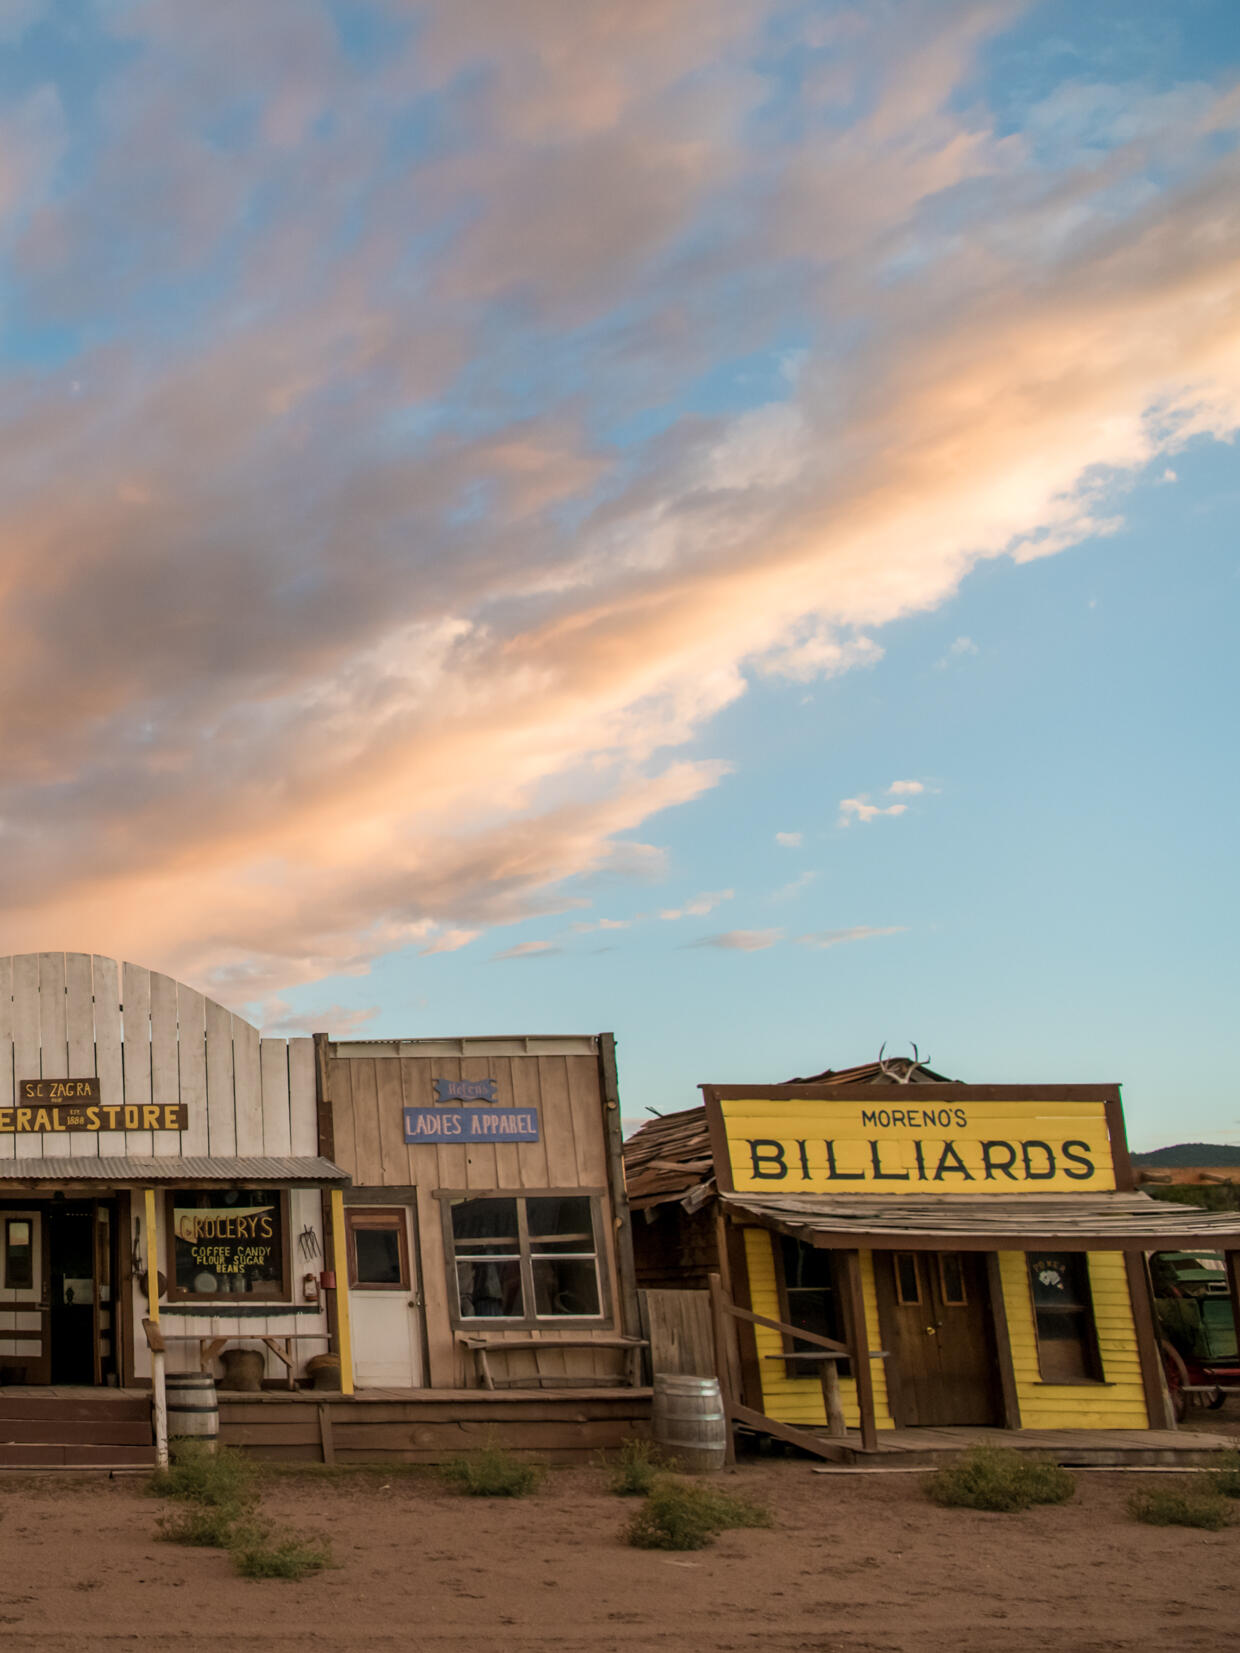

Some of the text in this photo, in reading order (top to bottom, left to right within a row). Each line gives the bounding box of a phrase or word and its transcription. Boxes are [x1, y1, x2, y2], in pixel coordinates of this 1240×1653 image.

[86, 1106, 180, 1130] STORE
[405, 1114, 537, 1136] LADIES APPAREL
[862, 1110, 967, 1127] MORENO'S
[745, 1139, 1096, 1181] BILLIARDS
[180, 1215, 273, 1238] GROCERYS
[191, 1247, 272, 1257] COFFEE CANDY
[196, 1256, 265, 1265] FLOUR SUGAR
[216, 1264, 246, 1273] BEANS
